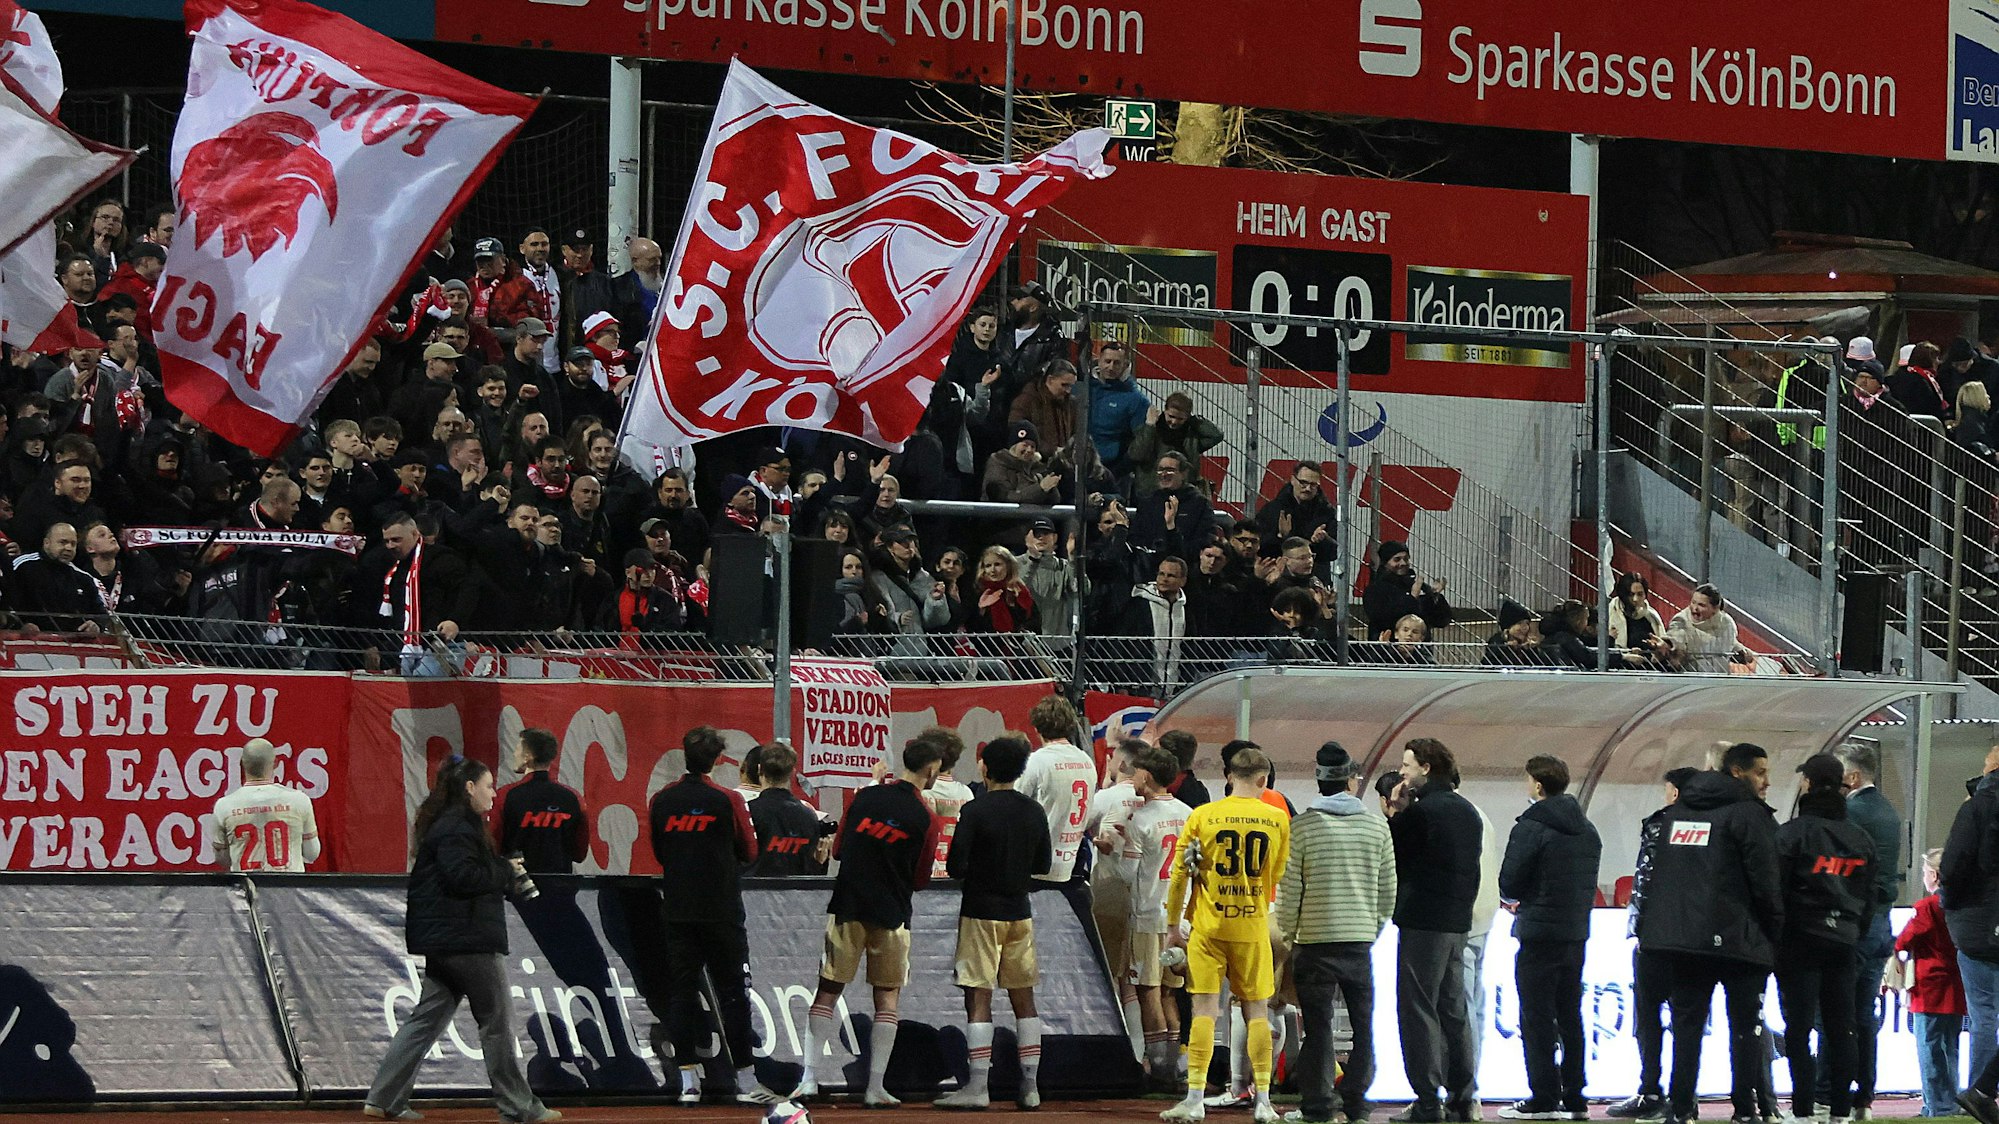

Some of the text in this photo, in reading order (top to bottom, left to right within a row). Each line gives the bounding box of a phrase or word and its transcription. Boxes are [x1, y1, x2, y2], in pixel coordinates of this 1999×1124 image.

[623, 0, 886, 33] passe
[1447, 26, 1896, 117] Sparkasse KölnBonn
[1962, 119, 1999, 152] La
[1125, 145, 1155, 161] WC
[1236, 202, 1391, 243] HEIM GAST
[1413, 281, 1565, 331] Kaloderma
[1464, 349, 1485, 360] SEIT
[158, 530, 181, 541] SC
[790, 665, 889, 688] SEKTION
[14, 684, 279, 737] STEH ZU
[807, 687, 891, 719] STADION
[806, 717, 889, 751] VERBOT
[810, 751, 843, 766] EAGLES
[845, 755, 866, 767] SEIT
[0, 748, 87, 802] EN
[1069, 780, 1088, 827] 3
[520, 811, 572, 828] HIT
[664, 814, 716, 832] HIT
[856, 817, 909, 844] HIT
[1225, 816, 1259, 824] FORTUNA
[234, 820, 290, 871] 20
[767, 835, 811, 854] HIT
[1671, 829, 1709, 843] HIT
[1158, 833, 1178, 880] 2
[1215, 829, 1270, 877] 30
[1811, 855, 1867, 877] HIT
[1218, 885, 1263, 897] WINKLER
